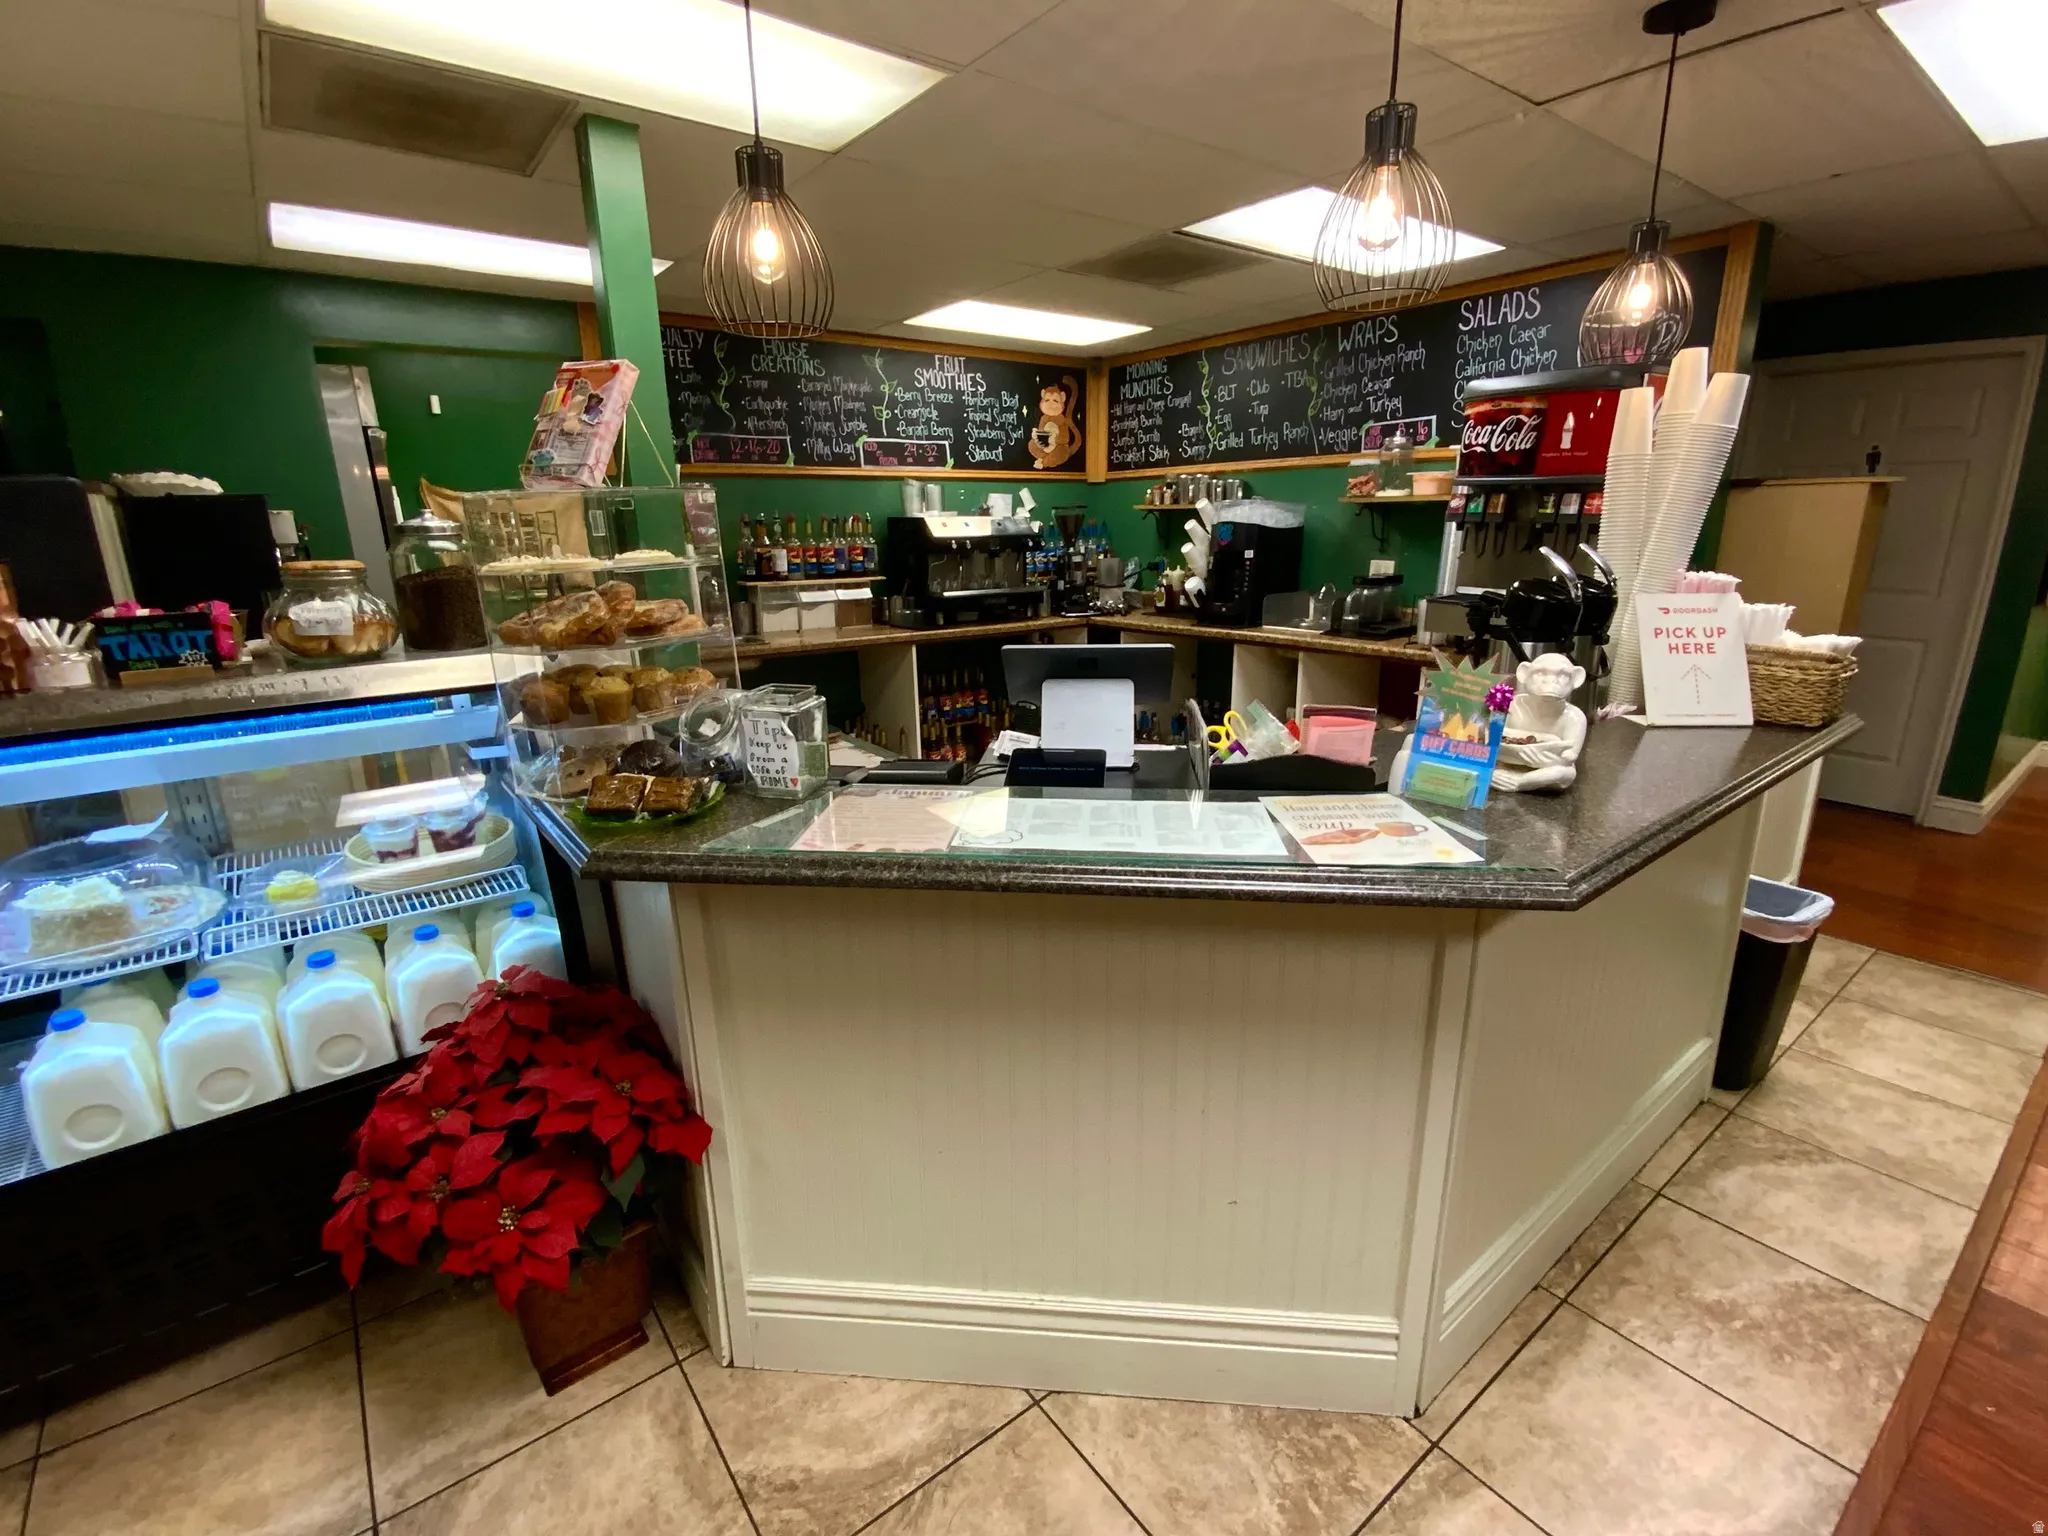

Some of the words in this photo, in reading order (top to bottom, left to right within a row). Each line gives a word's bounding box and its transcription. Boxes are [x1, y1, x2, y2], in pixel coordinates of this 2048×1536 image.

[1458, 287, 1542, 331] SALADS
[1338, 315, 1399, 353] WRAPS
[1456, 330, 1503, 359] Chicken
[1509, 324, 1552, 351] Caesar
[763, 338, 809, 359] HOUSE
[1221, 333, 1311, 375] SANDWICHES
[1358, 350, 1396, 378] Chicken
[1397, 340, 1426, 373] Ranch
[751, 355, 826, 377] CREATIONS
[934, 354, 967, 375] FRUIT
[1126, 358, 1168, 381] MORNING
[1454, 357, 1506, 379] California
[1510, 344, 1558, 376] Chicken
[914, 367, 987, 392] SMOOTHIES
[1120, 376, 1174, 400] MUNCHIES
[1250, 378, 1270, 396] Club
[897, 387, 921, 407] Berry
[924, 387, 954, 403] Breeze
[1001, 390, 1019, 410] Blast
[1217, 383, 1238, 402] BLT
[1323, 381, 1358, 404] Chicken
[897, 404, 940, 424] Creamsicle
[966, 408, 992, 426] Tropical
[993, 407, 1018, 428] Sunset
[1216, 407, 1233, 432] Egg
[1252, 401, 1269, 422] Tuna
[1323, 405, 1345, 425] Ham
[1348, 401, 1363, 414] and
[1366, 394, 1403, 420] Turkey
[899, 421, 929, 440] Banana
[930, 421, 954, 443] Berry
[967, 422, 1007, 443] Strawberry
[1216, 431, 1244, 451] Grilled
[1248, 426, 1279, 452] Turkey
[1283, 420, 1310, 444] Ranch
[1417, 421, 1429, 435] 16
[1461, 414, 1543, 453] Coca-Cola
[730, 438, 744, 454] 12
[749, 438, 763, 454] 16
[766, 439, 781, 454] 20
[805, 437, 833, 462] Milky
[832, 437, 857, 461] Way
[1319, 426, 1359, 452] Veggie
[903, 443, 917, 457] 24
[923, 444, 940, 457] 32
[967, 444, 1004, 462] Starburst
[1672, 606, 1718, 615] DOORDASH
[1653, 626, 1698, 640] PICK
[1703, 626, 1727, 639] UP
[97, 629, 213, 661] TAROT
[1668, 642, 1717, 655] HERE
[748, 719, 787, 743] Tips
[749, 736, 771, 753] Keep
[776, 743, 788, 751] us
[1448, 740, 1491, 759] CARDS
[749, 752, 776, 763] from
[775, 765, 787, 775] of
[1282, 804, 1319, 813] Ham
[1322, 803, 1354, 811] and
[1355, 802, 1403, 811] cheese
[1292, 813, 1358, 822] croissant
[1363, 812, 1399, 820] with
[1298, 821, 1353, 833] soup
